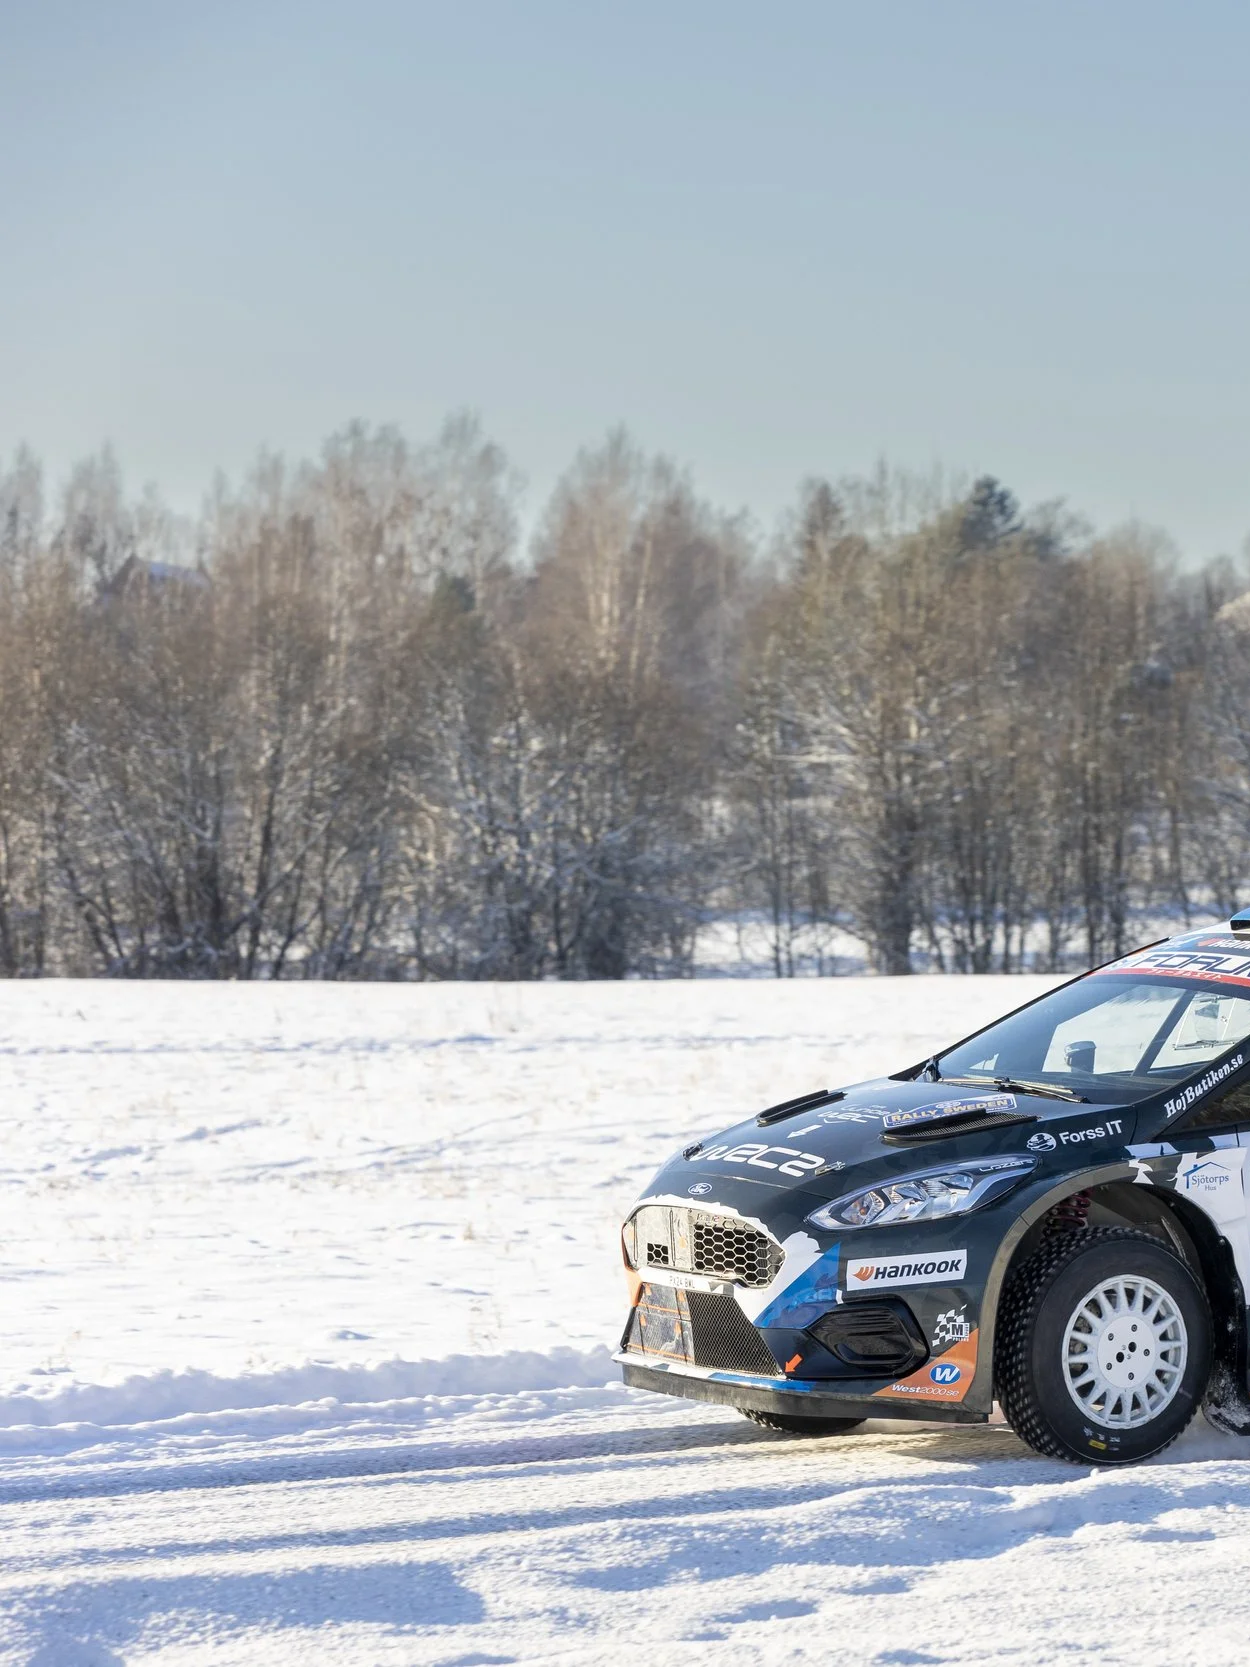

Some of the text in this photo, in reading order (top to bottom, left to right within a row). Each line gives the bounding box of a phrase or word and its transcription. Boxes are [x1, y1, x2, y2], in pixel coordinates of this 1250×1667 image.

[891, 1108, 938, 1122] RALLY
[944, 1098, 1009, 1114] SWEDEN
[1059, 1119, 1123, 1145] Forss IT
[1191, 1172, 1230, 1187] Sjötorps
